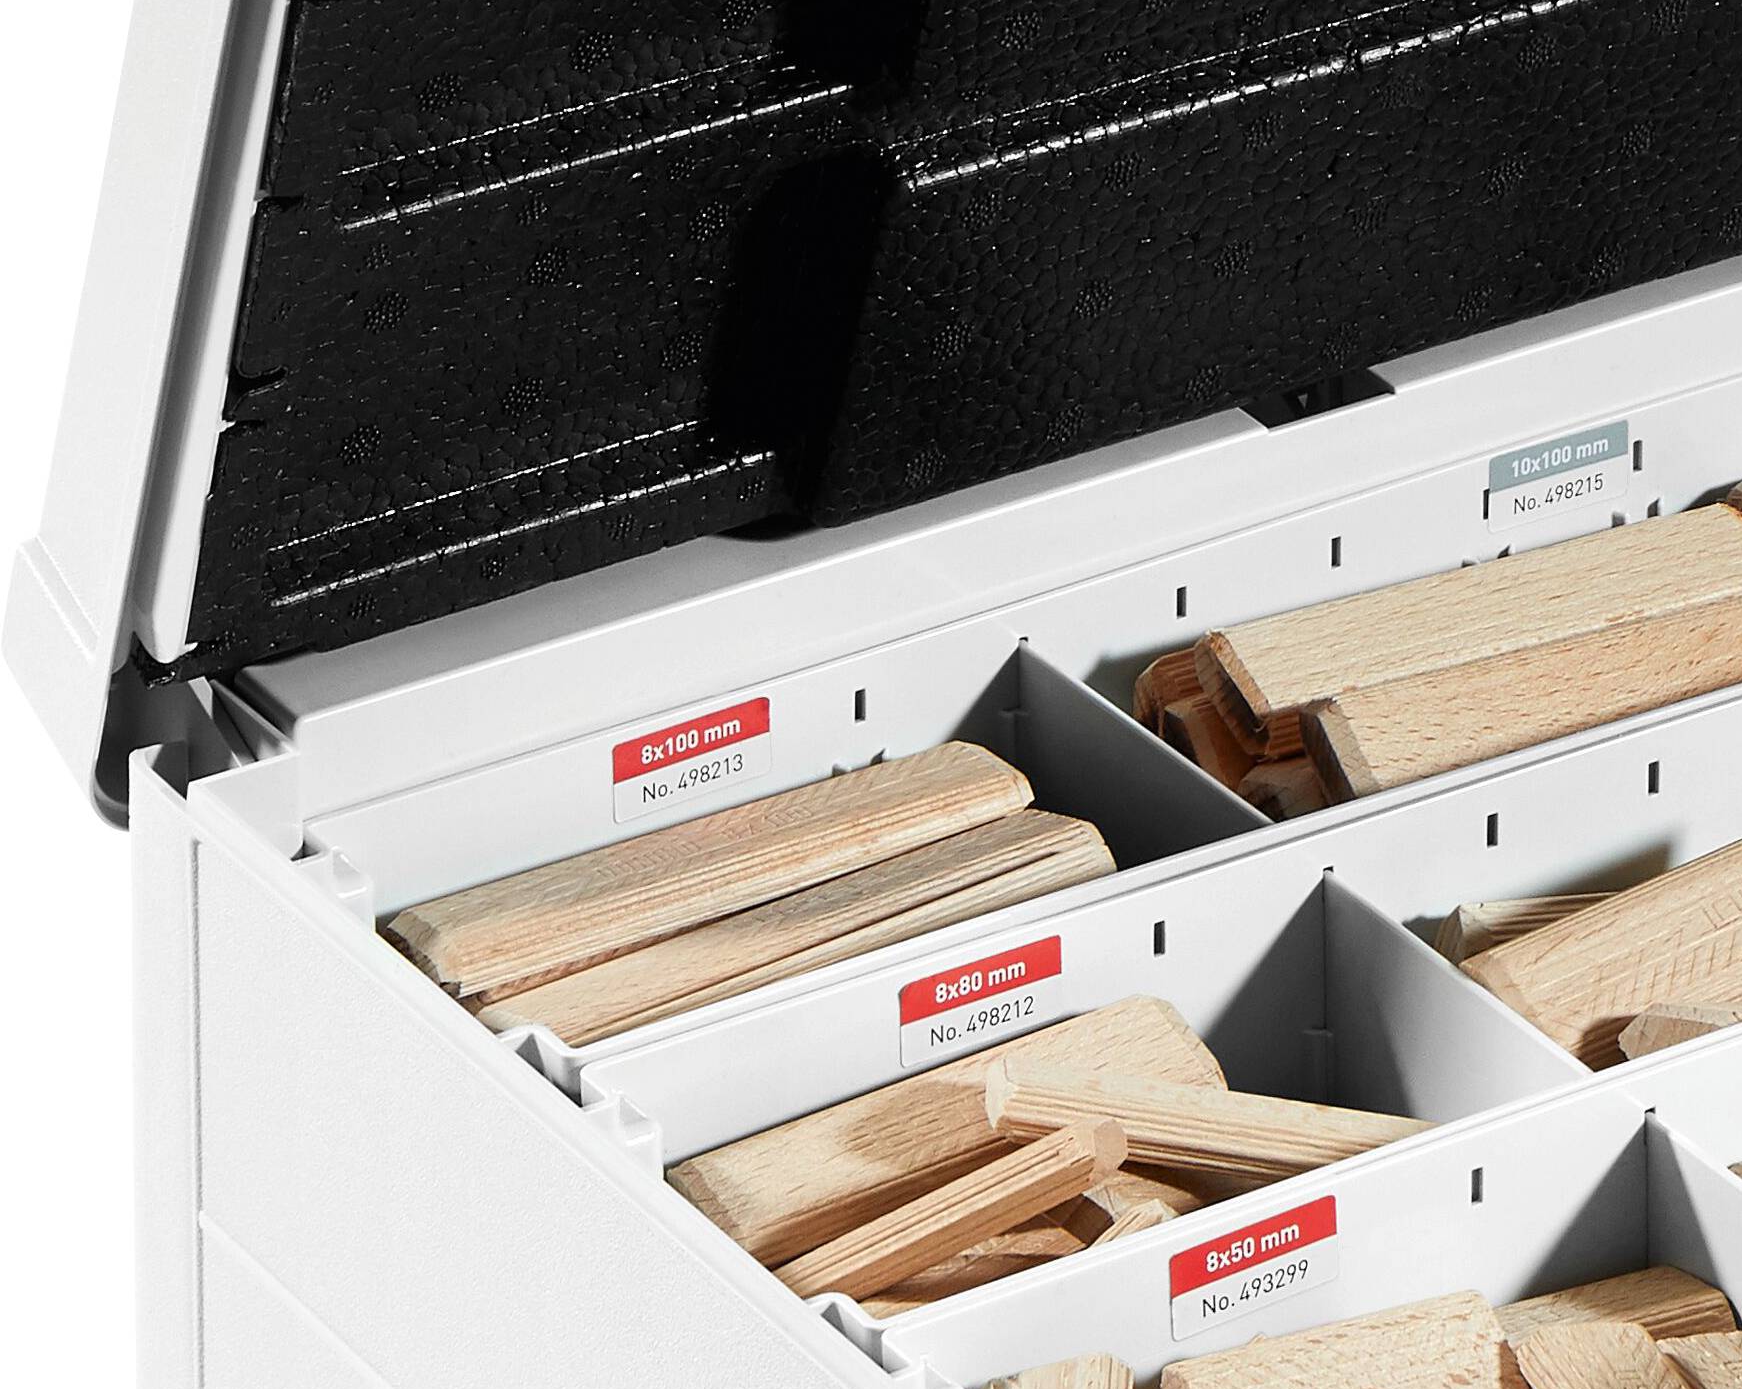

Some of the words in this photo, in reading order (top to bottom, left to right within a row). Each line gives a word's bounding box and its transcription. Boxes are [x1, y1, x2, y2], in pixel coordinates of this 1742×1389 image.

[1512, 446, 1572, 478] 10x100
[1576, 439, 1608, 460] mm
[1513, 495, 1541, 515] No.
[1545, 473, 1604, 505] 498215
[641, 729, 699, 764] 8x100
[703, 719, 741, 745] mm
[642, 782, 673, 804] No.
[677, 753, 743, 790] 498213
[935, 971, 983, 1003] 8x80
[988, 961, 1026, 987] mm
[930, 1025, 962, 1047] No.
[966, 995, 1034, 1032] 498212
[1206, 1237, 1255, 1273] 8x50
[1260, 1223, 1300, 1252] mm
[1202, 1294, 1235, 1318] No.
[1239, 1259, 1308, 1302] 493299
